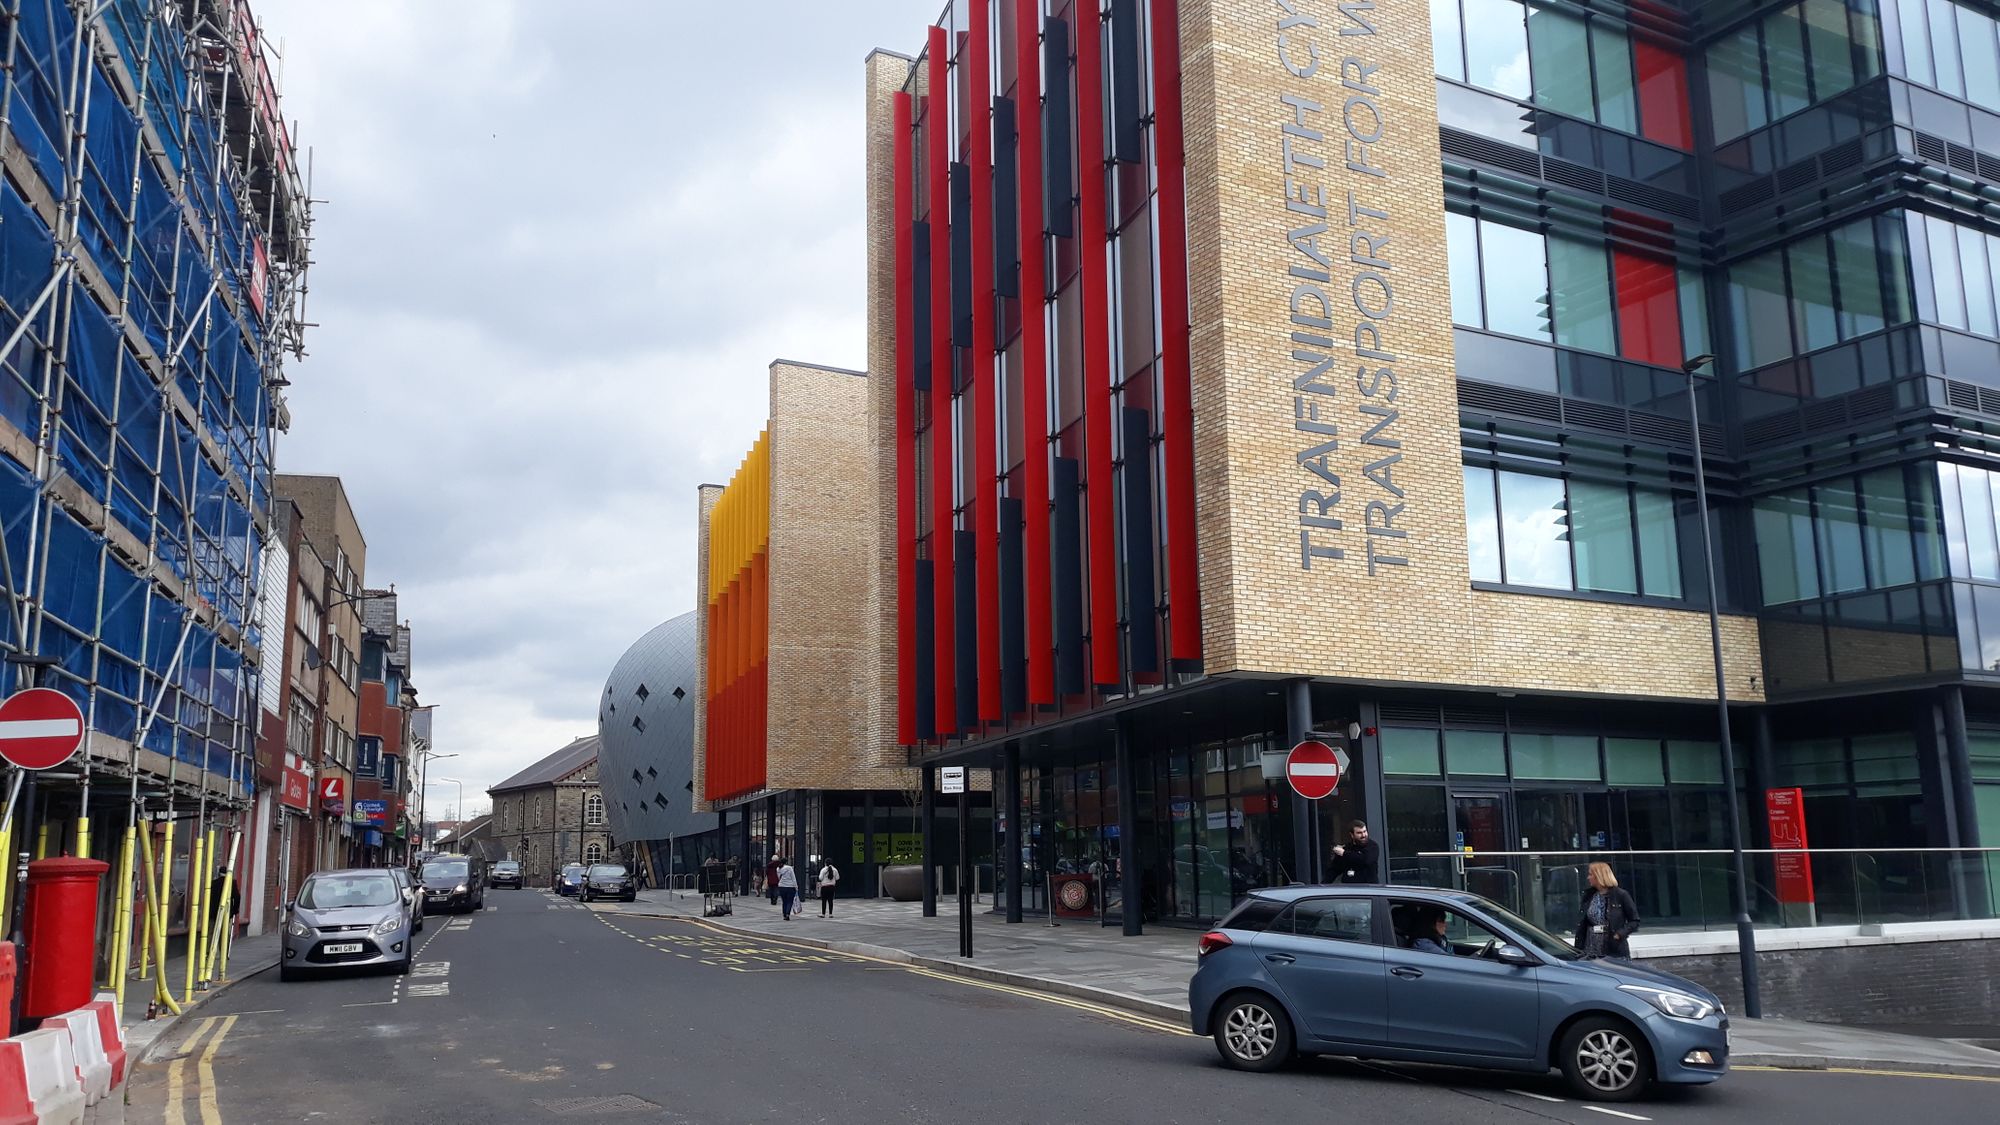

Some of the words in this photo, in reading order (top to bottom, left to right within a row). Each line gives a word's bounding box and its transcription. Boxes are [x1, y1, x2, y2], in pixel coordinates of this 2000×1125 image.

[1342, 56, 1387, 178] FOR
[1280, 93, 1345, 571] TRAFNIDIAETH
[1348, 190, 1409, 577] TRANSPORT
